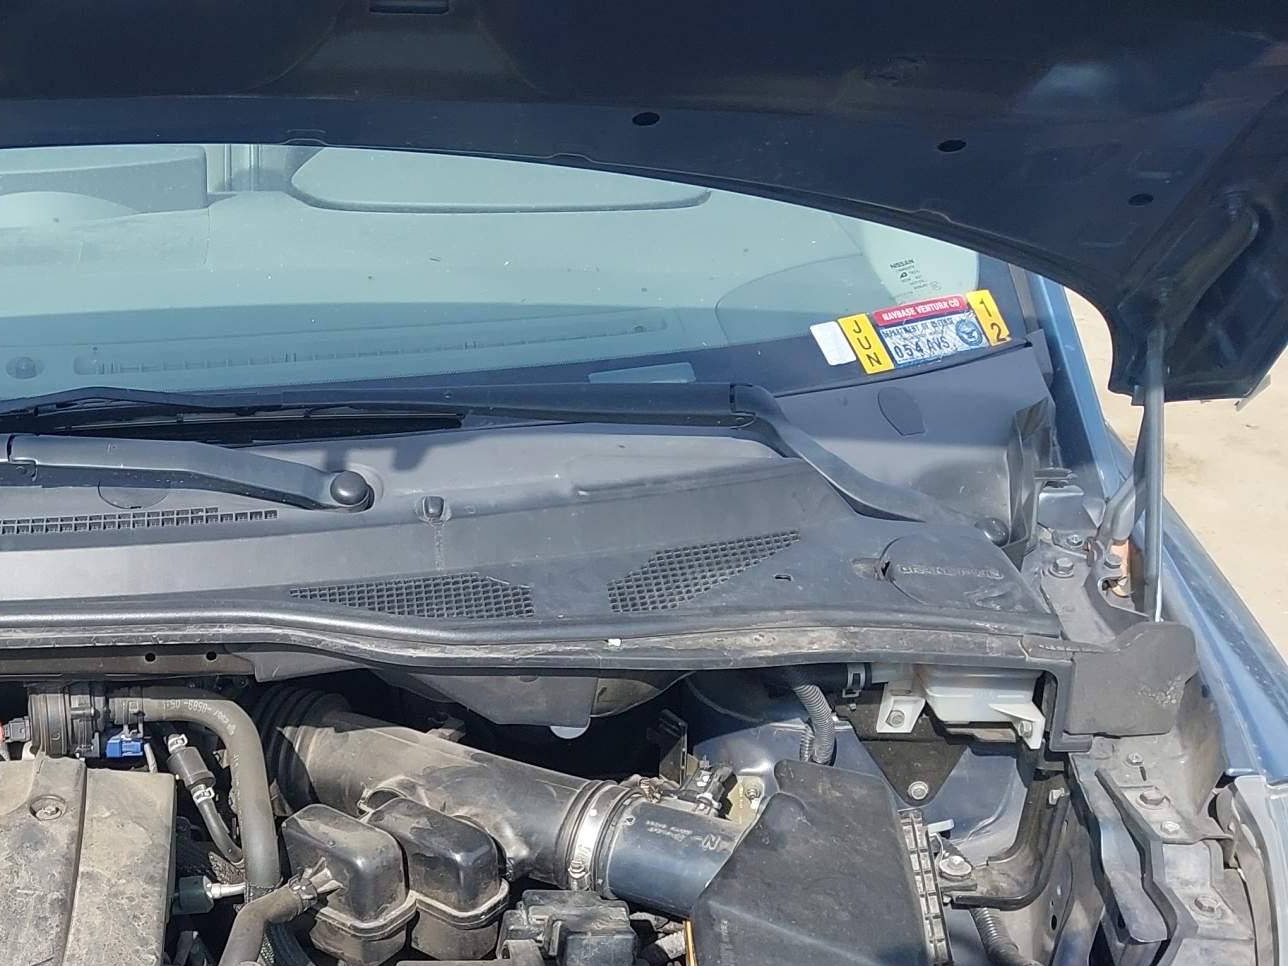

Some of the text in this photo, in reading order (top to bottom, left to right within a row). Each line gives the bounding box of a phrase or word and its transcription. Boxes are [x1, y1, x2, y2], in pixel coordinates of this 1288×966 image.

[882, 306, 917, 320] NAVBASE
[917, 302, 950, 314] VENTURA
[882, 325, 920, 338] DEPARTMENT
[921, 322, 928, 330] OF
[931, 318, 954, 328] DEFENSE
[894, 342, 924, 358] 054
